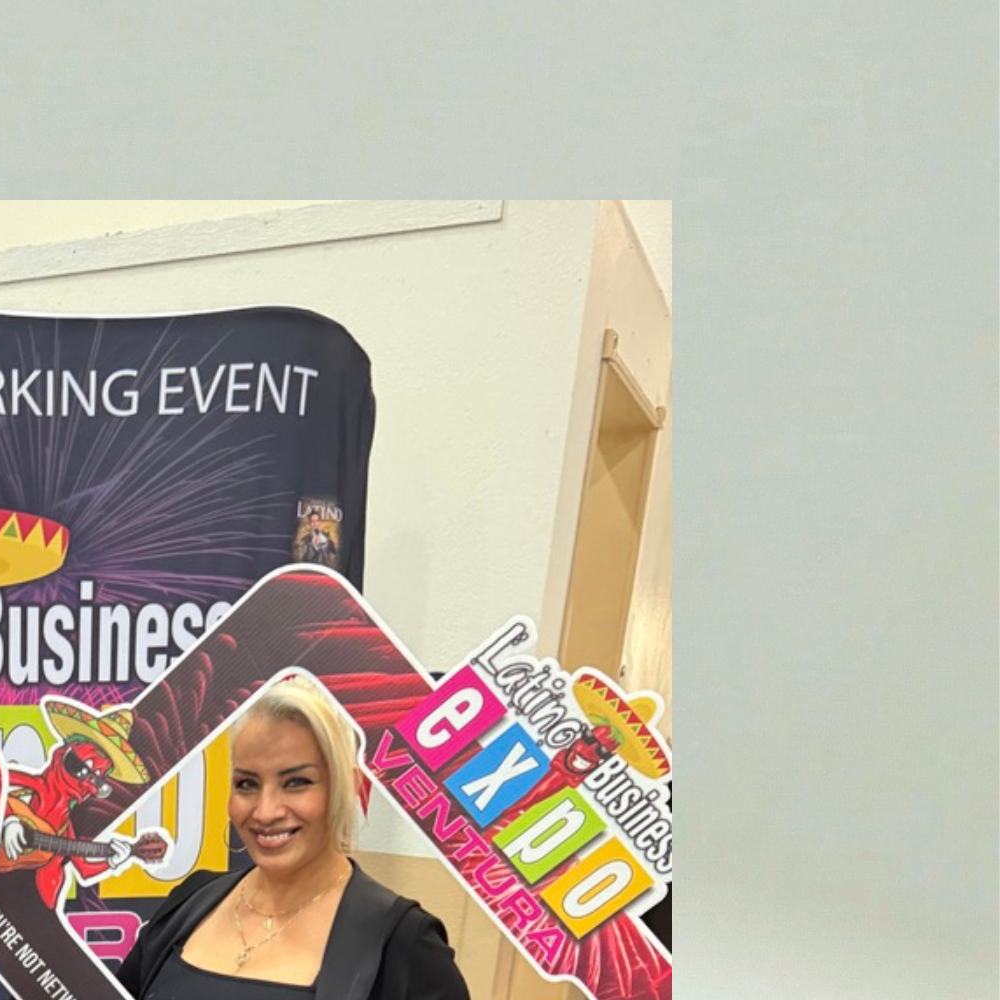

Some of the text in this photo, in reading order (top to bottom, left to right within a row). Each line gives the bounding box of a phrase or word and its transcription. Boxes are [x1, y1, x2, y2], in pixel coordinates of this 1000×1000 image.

[157, 361, 319, 417] EVENT
[471, 622, 576, 750] Latino
[371, 729, 568, 966] VENTURA
[416, 686, 634, 919] expo
[14, 942, 47, 974] NOT
